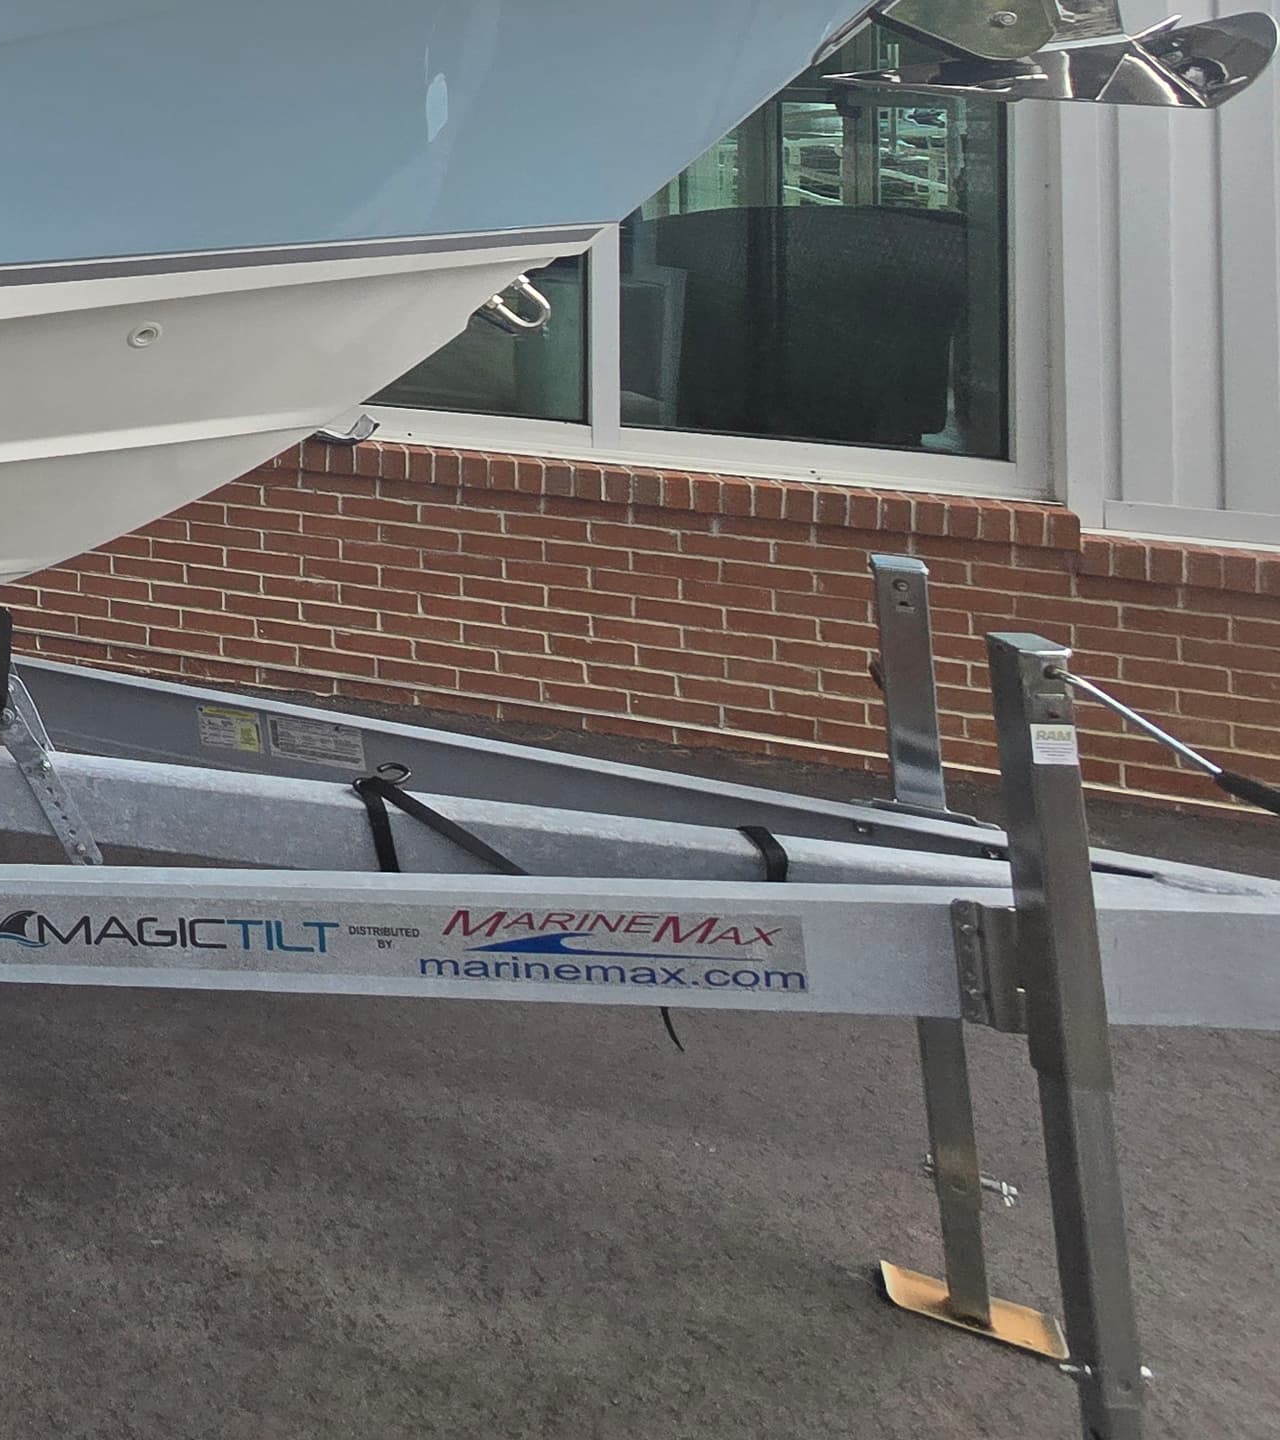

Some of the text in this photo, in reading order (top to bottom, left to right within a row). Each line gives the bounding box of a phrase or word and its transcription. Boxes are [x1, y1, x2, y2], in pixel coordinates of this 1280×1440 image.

[37, 915, 340, 953] MAGICTILT
[348, 925, 421, 938] DISTRIBUTED
[377, 940, 393, 950] BY
[419, 956, 806, 990] marinemax.com
